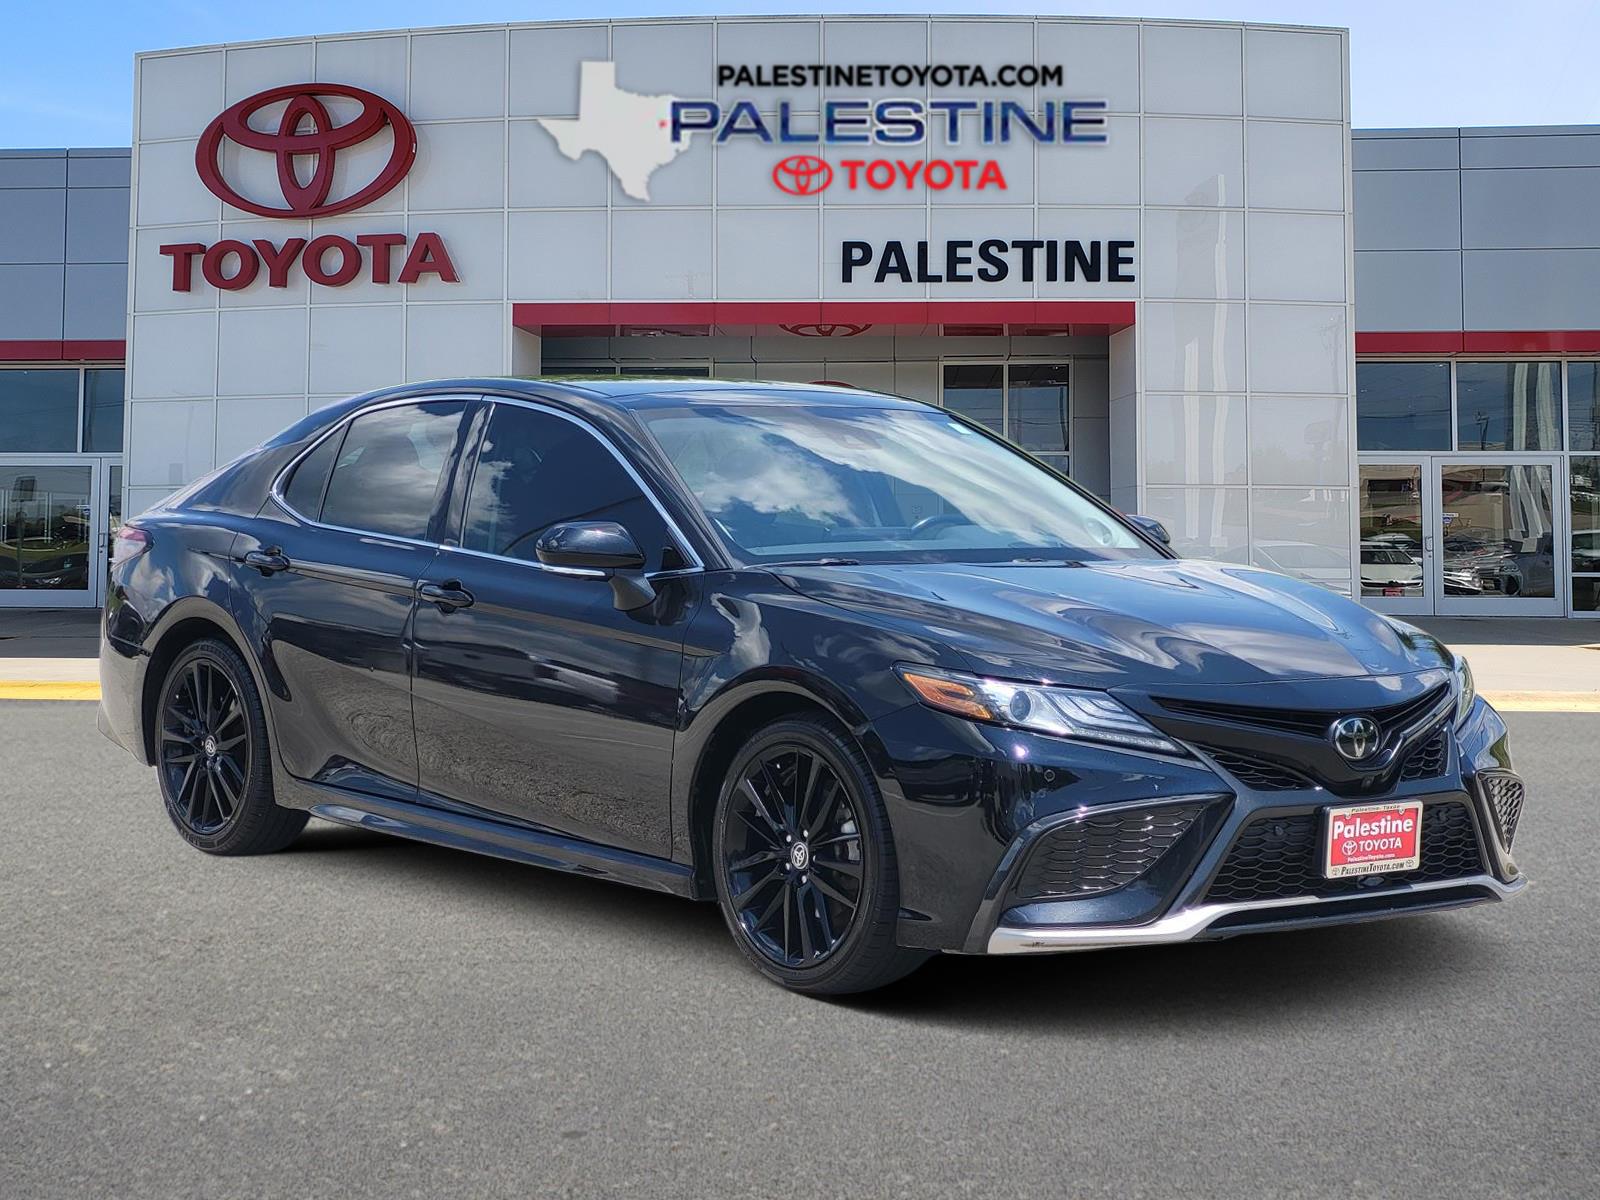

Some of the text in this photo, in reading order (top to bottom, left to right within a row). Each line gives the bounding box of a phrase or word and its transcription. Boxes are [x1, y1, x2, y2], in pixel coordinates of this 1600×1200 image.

[159, 231, 461, 292] TOYOTA
[842, 239, 1136, 284] PALESTINE
[1333, 815, 1414, 840] Palestine
[1358, 837, 1403, 852] TOYOTA
